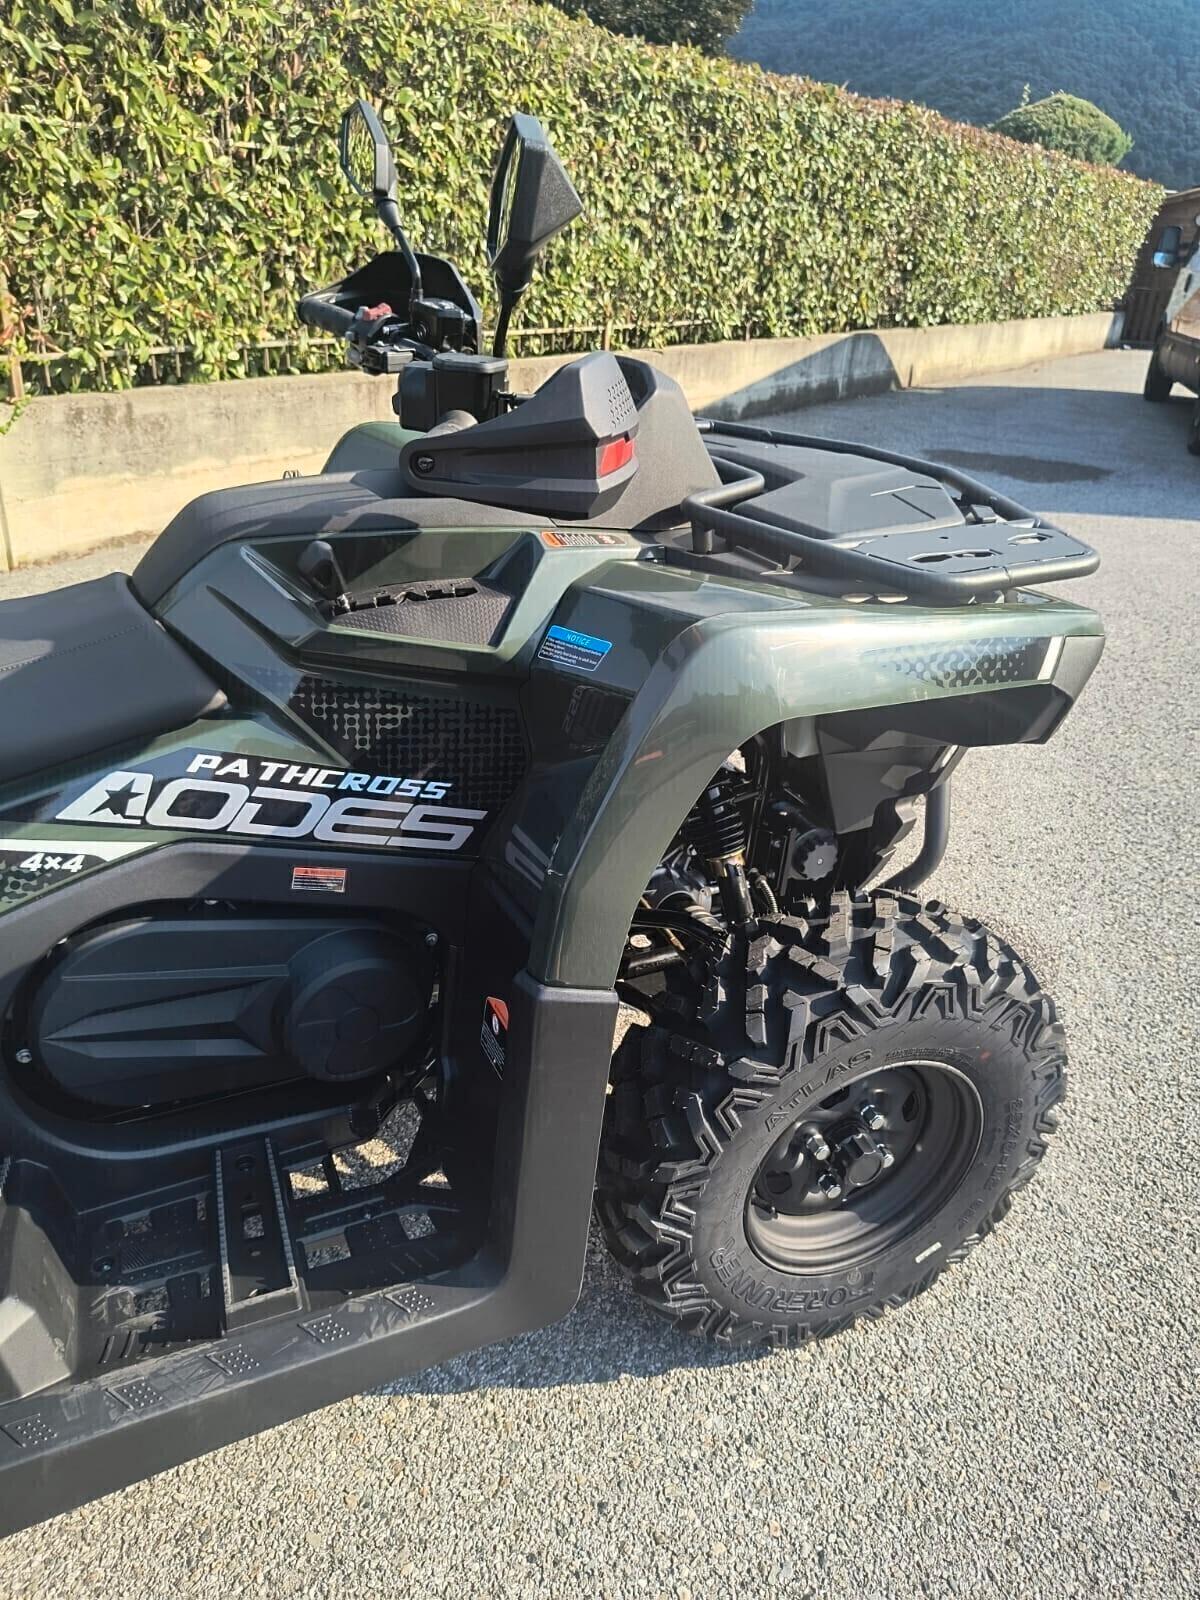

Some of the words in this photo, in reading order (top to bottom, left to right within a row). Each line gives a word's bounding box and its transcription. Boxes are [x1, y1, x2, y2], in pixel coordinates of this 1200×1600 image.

[567, 633, 591, 647] NOTICE
[55, 770, 489, 851] AODES
[186, 753, 452, 800] PATHCROSS
[764, 1048, 873, 1133] ATLAS
[709, 1238, 874, 1314] FORERUNNER
